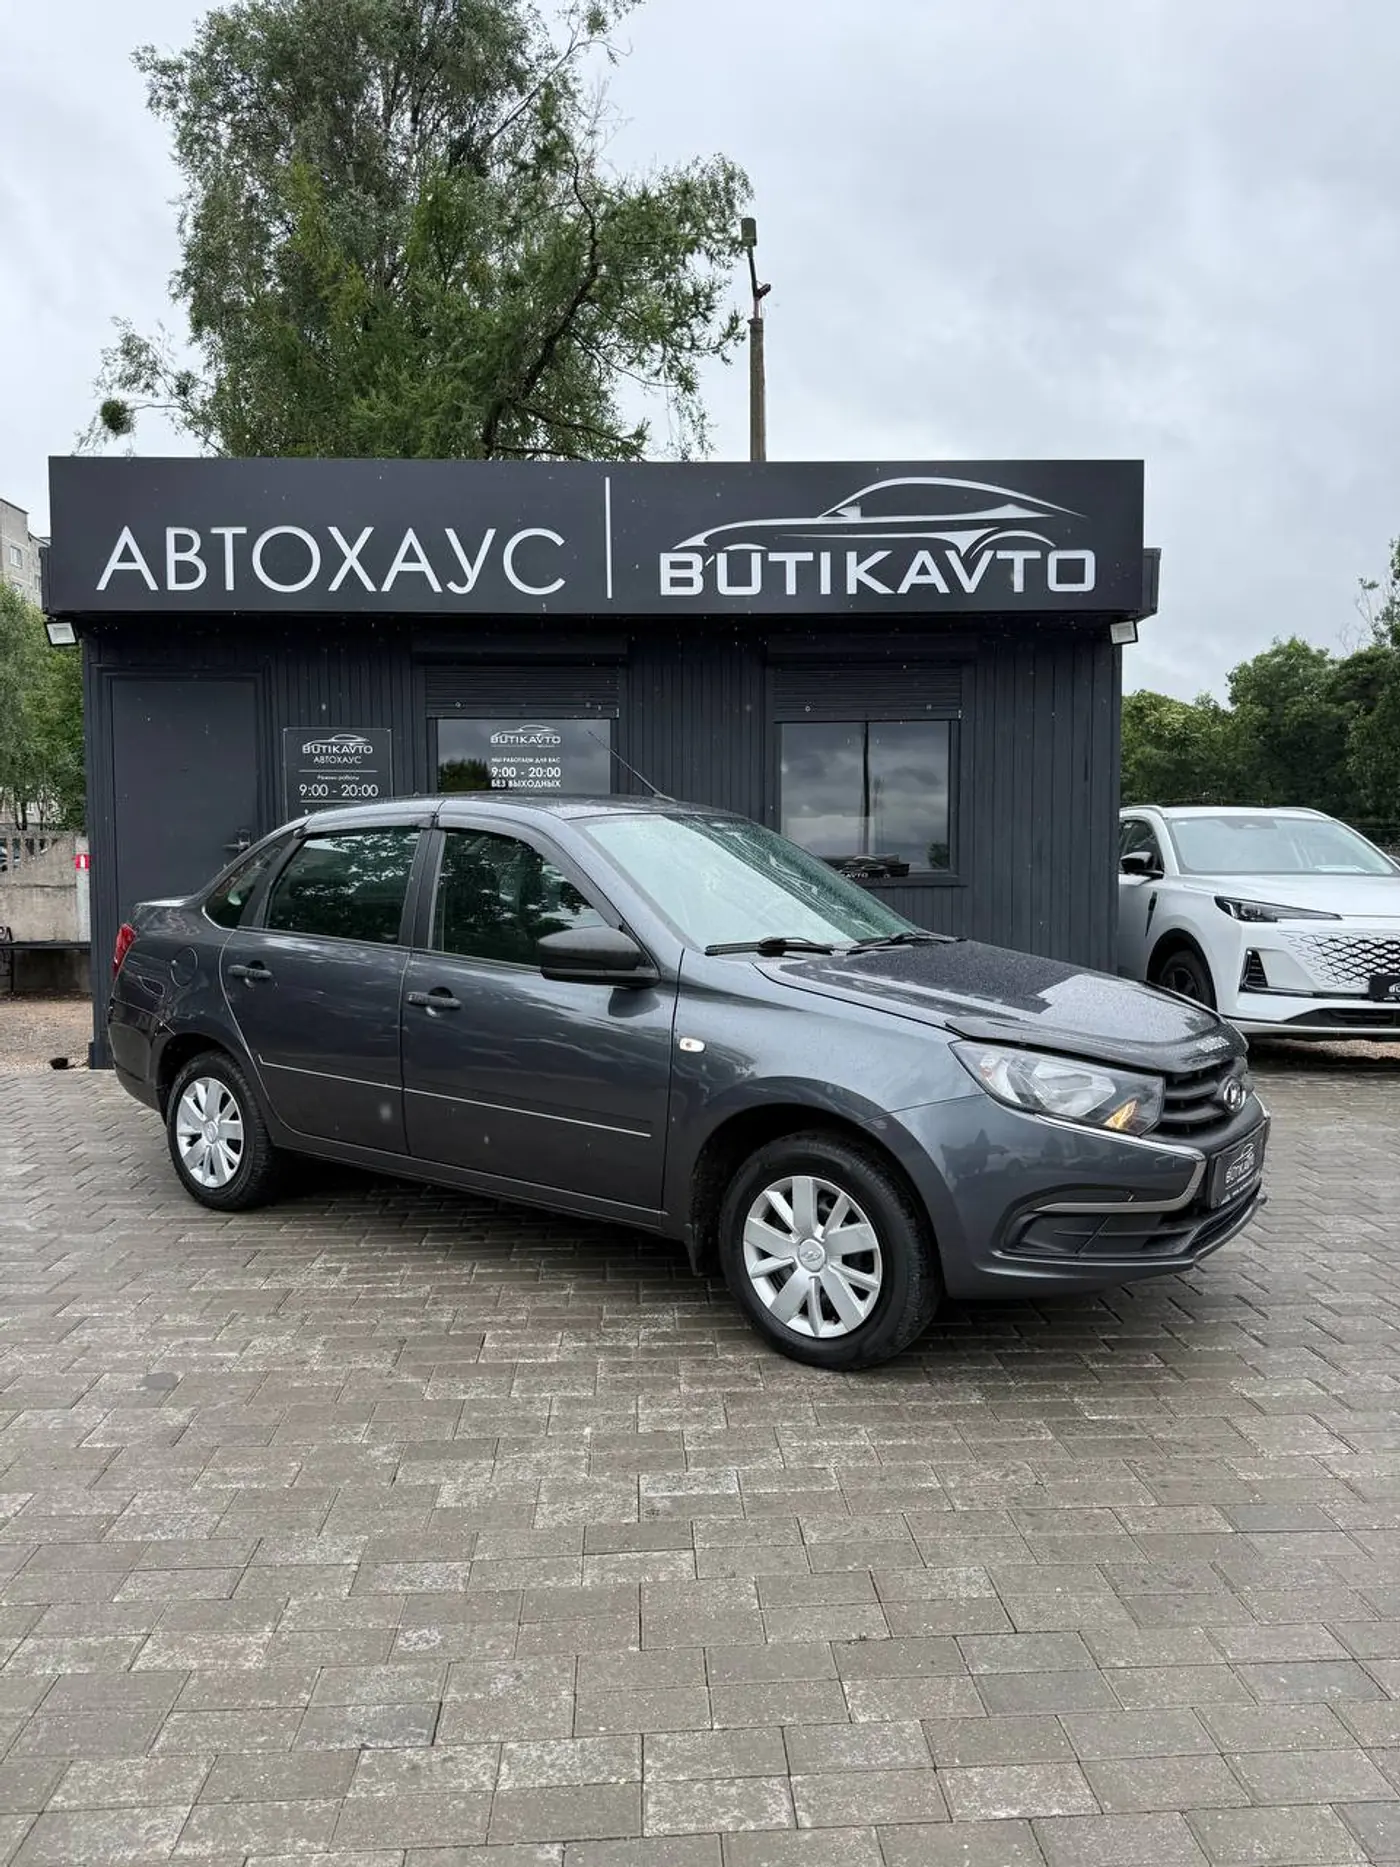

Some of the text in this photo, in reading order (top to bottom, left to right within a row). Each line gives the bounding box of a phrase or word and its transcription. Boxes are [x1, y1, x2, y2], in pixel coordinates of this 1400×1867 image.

[96, 525, 566, 595] АВТОХАУС
[659, 549, 1096, 596] BUTIKAVTO
[490, 735, 562, 744] BUTIKAVTO
[302, 744, 373, 754] BUTIKAVTO
[313, 755, 363, 764] АВТОХАУС
[491, 766, 517, 778] 9:00
[528, 766, 562, 778] 20:00
[299, 783, 328, 797] 9:00
[341, 783, 379, 797] 20:00
